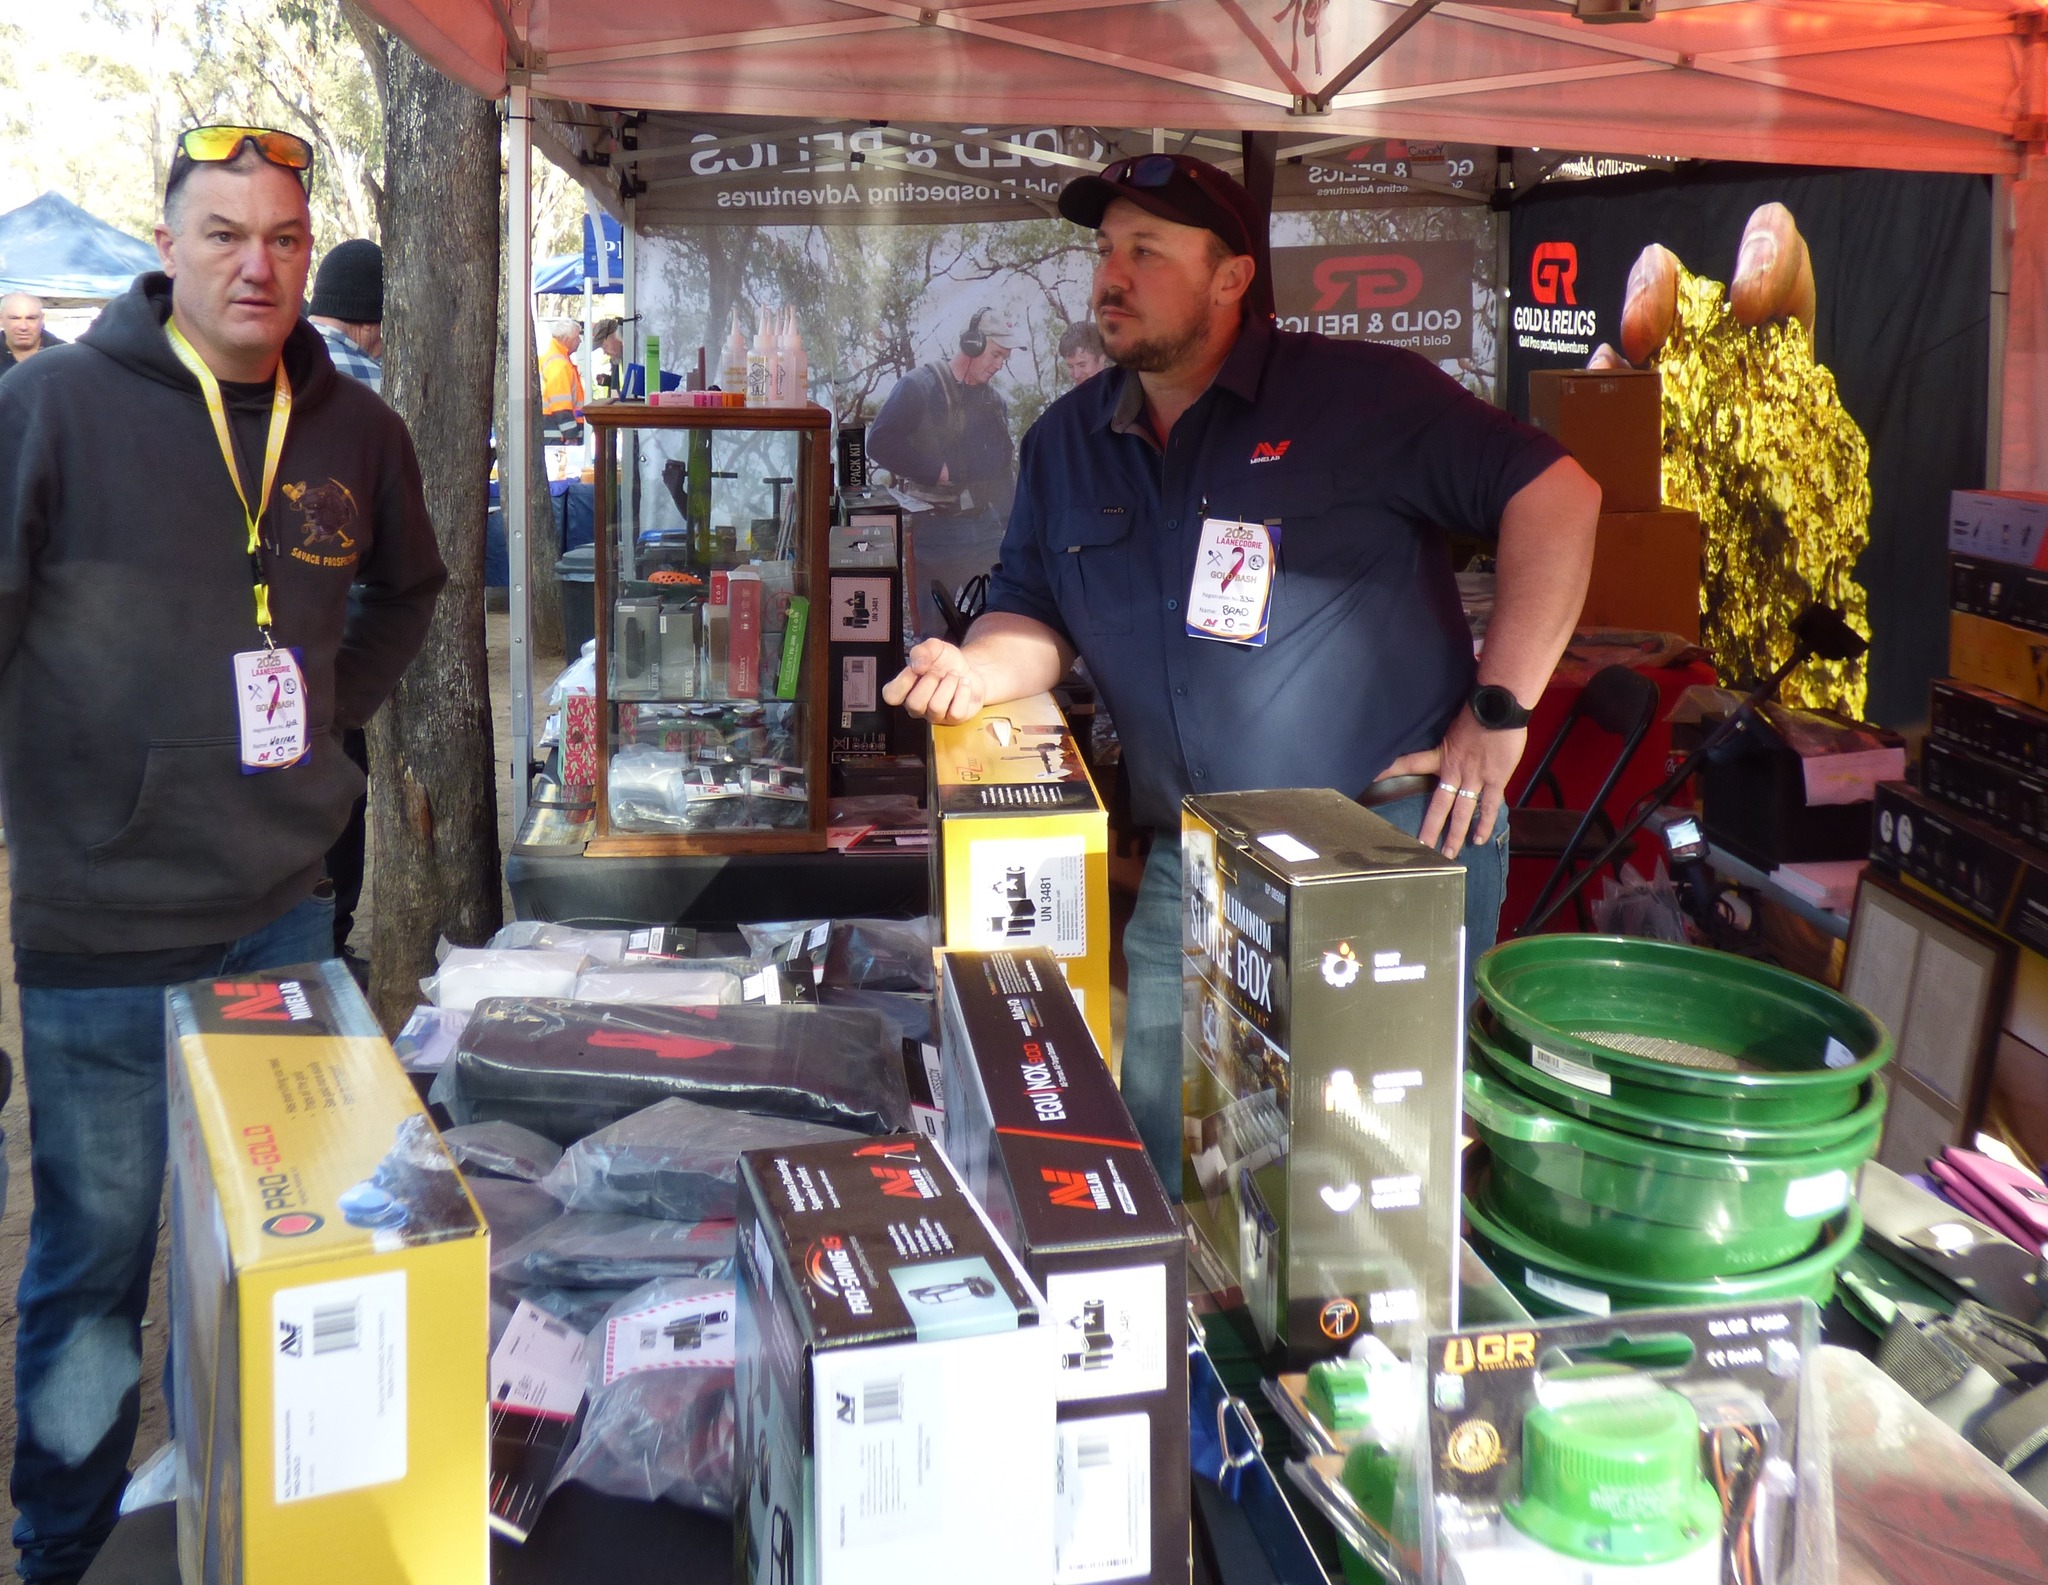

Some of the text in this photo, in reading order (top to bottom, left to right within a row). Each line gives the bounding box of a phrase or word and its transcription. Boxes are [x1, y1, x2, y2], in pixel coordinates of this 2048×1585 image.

[1532, 241, 1578, 305] GR
[1514, 306, 1597, 336] GOLD & RELICS
[1519, 334, 1530, 348] Gold
[1557, 339, 1589, 355] Adventures
[849, 442, 861, 457] KIT
[1250, 455, 1281, 465] MINELAB
[1224, 527, 1254, 541] 2025
[291, 547, 320, 566] SAVAGE
[1210, 569, 1258, 585] GOLD BASH
[872, 613, 879, 622] UN
[256, 655, 281, 669] 2025
[269, 734, 297, 746] Warren
[1040, 877, 1052, 922] UN 3481
[1191, 863, 1219, 910] FOLD
[1222, 890, 1272, 953] ALUMINUM
[1191, 894, 1272, 1013] SLUICE BOX
[279, 981, 313, 1021] MINELAB
[1021, 1042, 1067, 1121] EQUINOX 900
[796, 1167, 813, 1188] Comfort
[908, 1169, 935, 1199] MINELAB
[1084, 1172, 1111, 1210] MINELAB
[827, 1249, 873, 1315] PRO-SWING
